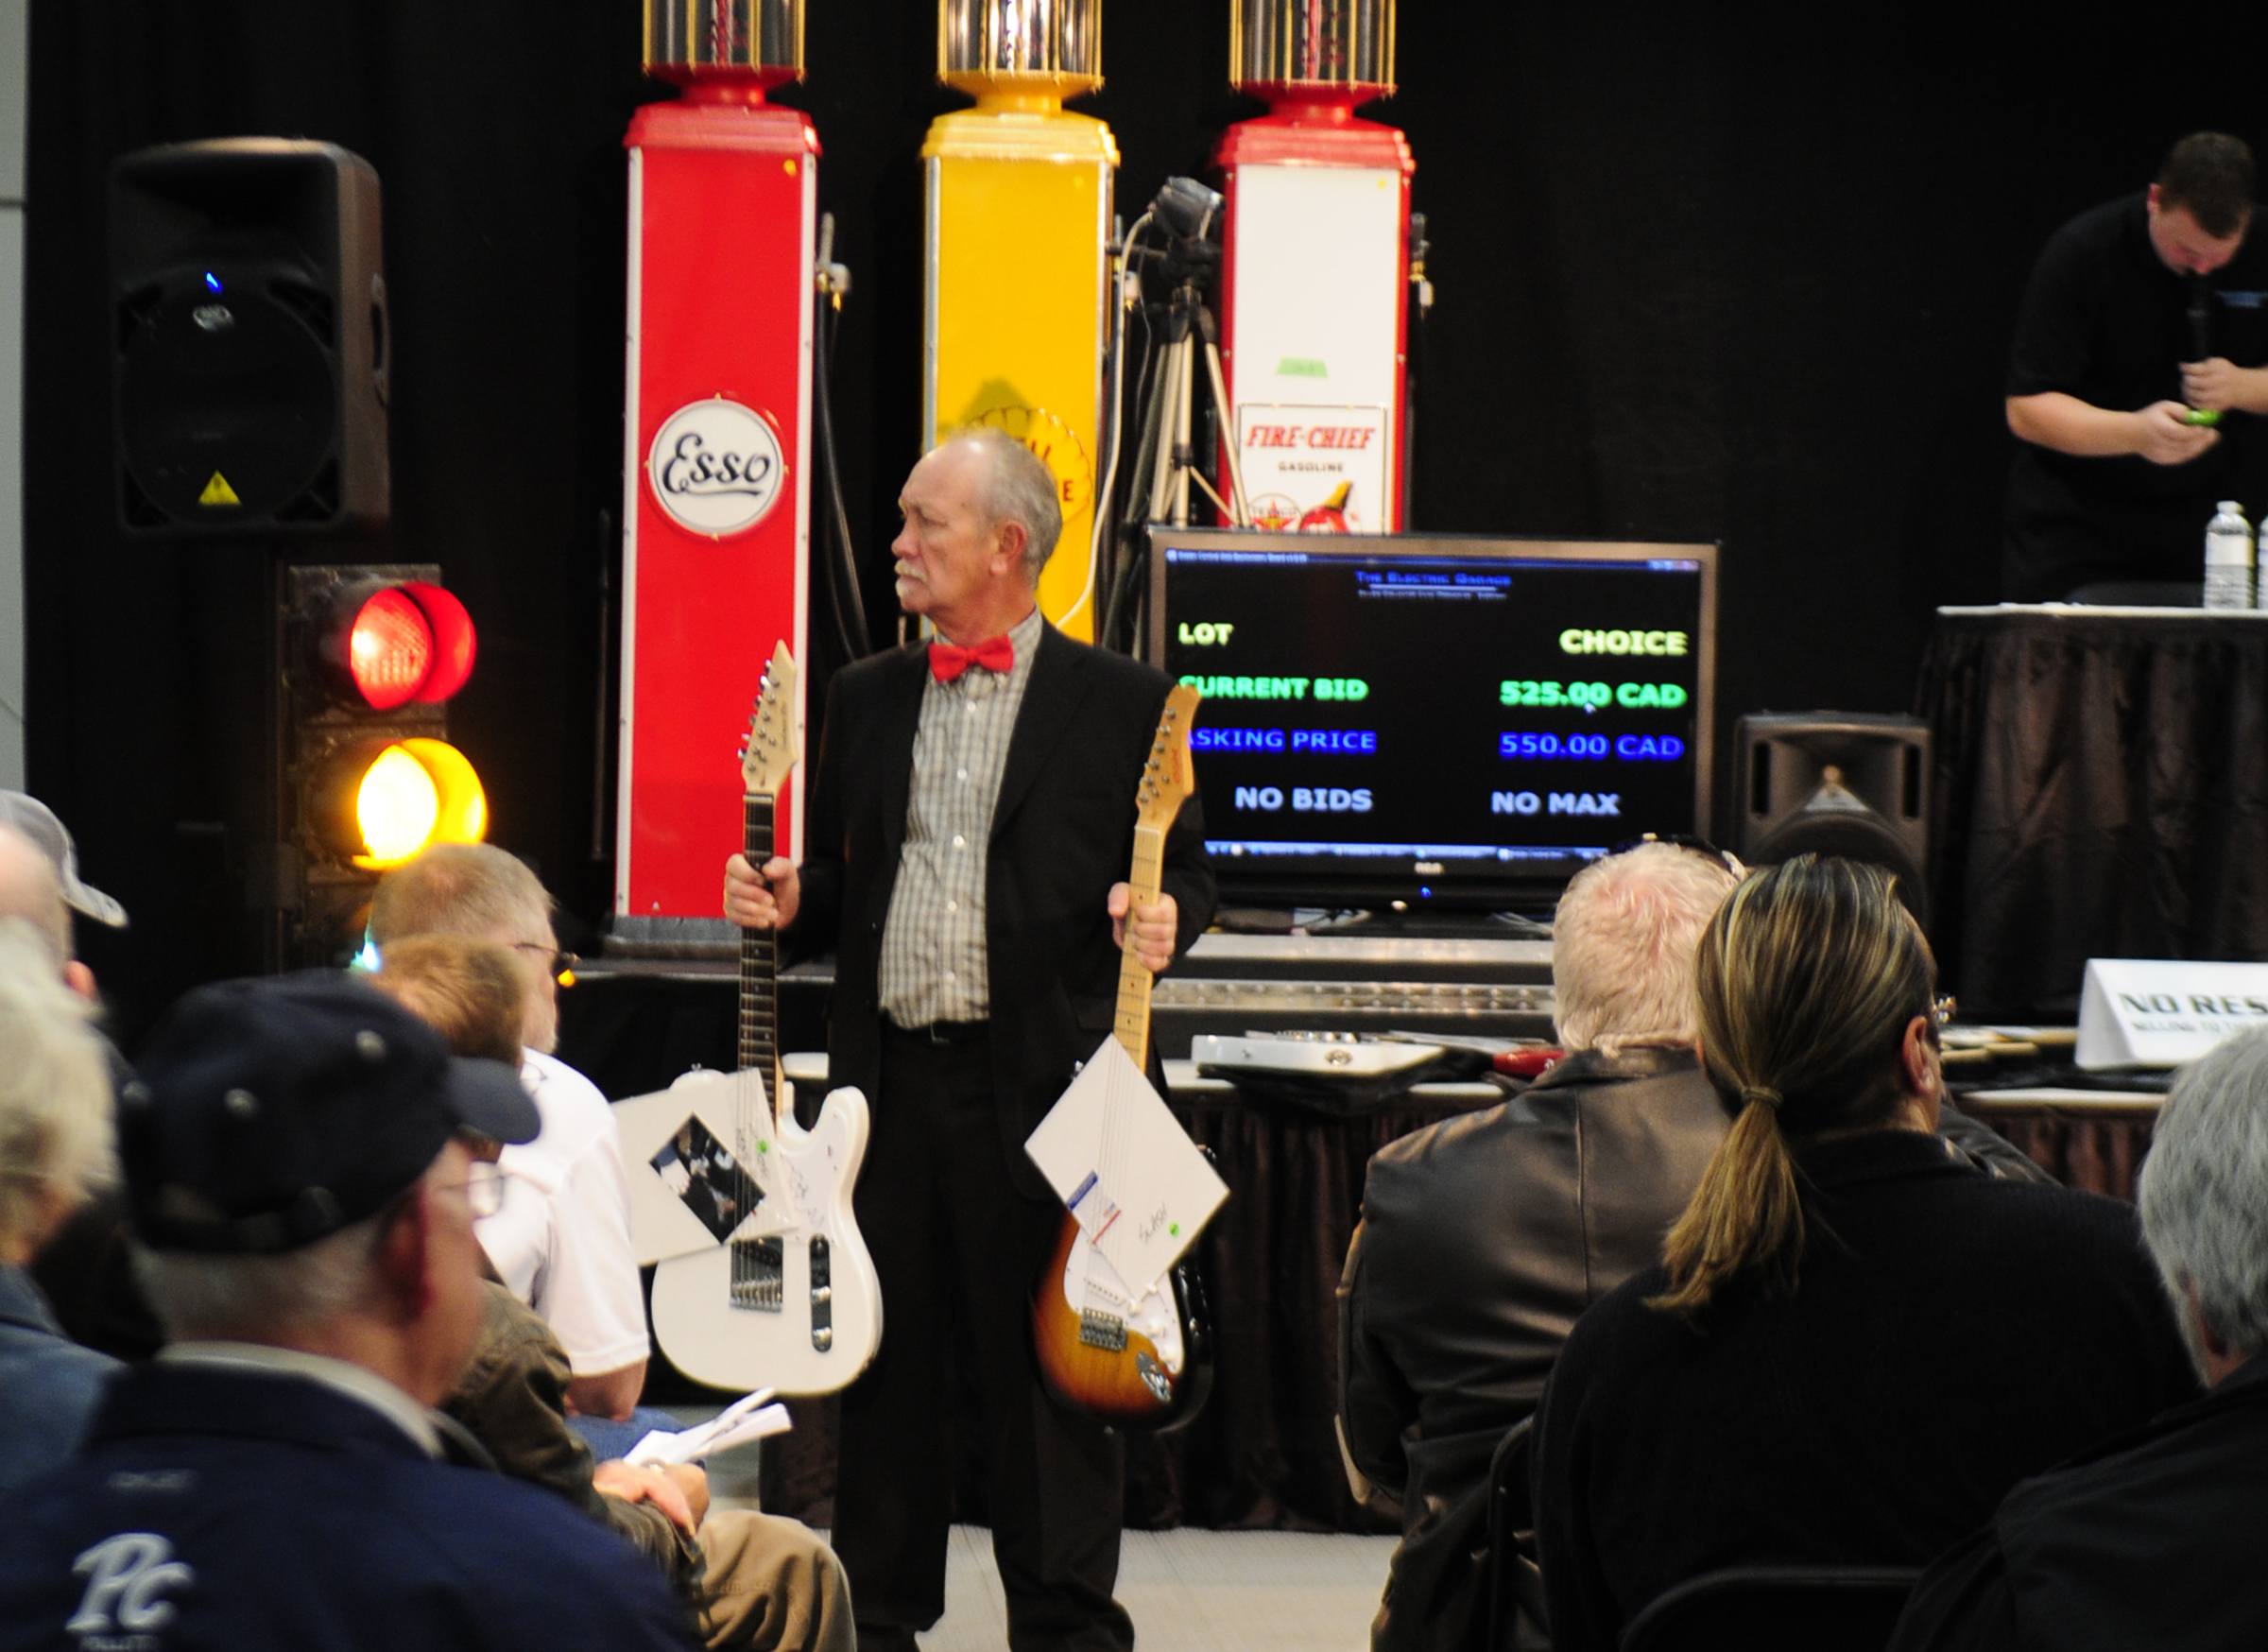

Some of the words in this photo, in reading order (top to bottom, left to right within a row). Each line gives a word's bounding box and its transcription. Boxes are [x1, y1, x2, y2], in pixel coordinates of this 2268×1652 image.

[662, 433, 770, 496] Esso
[1279, 460, 1344, 472] GASOLINE
[1178, 622, 1233, 645] LOT
[1559, 628, 1689, 656] CHOICE
[1314, 678, 1369, 700] BID
[1500, 680, 1612, 707] 525.00
[1616, 682, 1688, 708] CAD
[1291, 730, 1376, 751] PRICE
[1501, 732, 1609, 757] 550.00
[1616, 733, 1684, 759] CAD
[1234, 787, 1283, 810] NO
[1292, 788, 1373, 812] BIDS
[1491, 792, 1539, 814] NO
[1549, 793, 1621, 816] MAX
[2119, 993, 2180, 1013] NO
